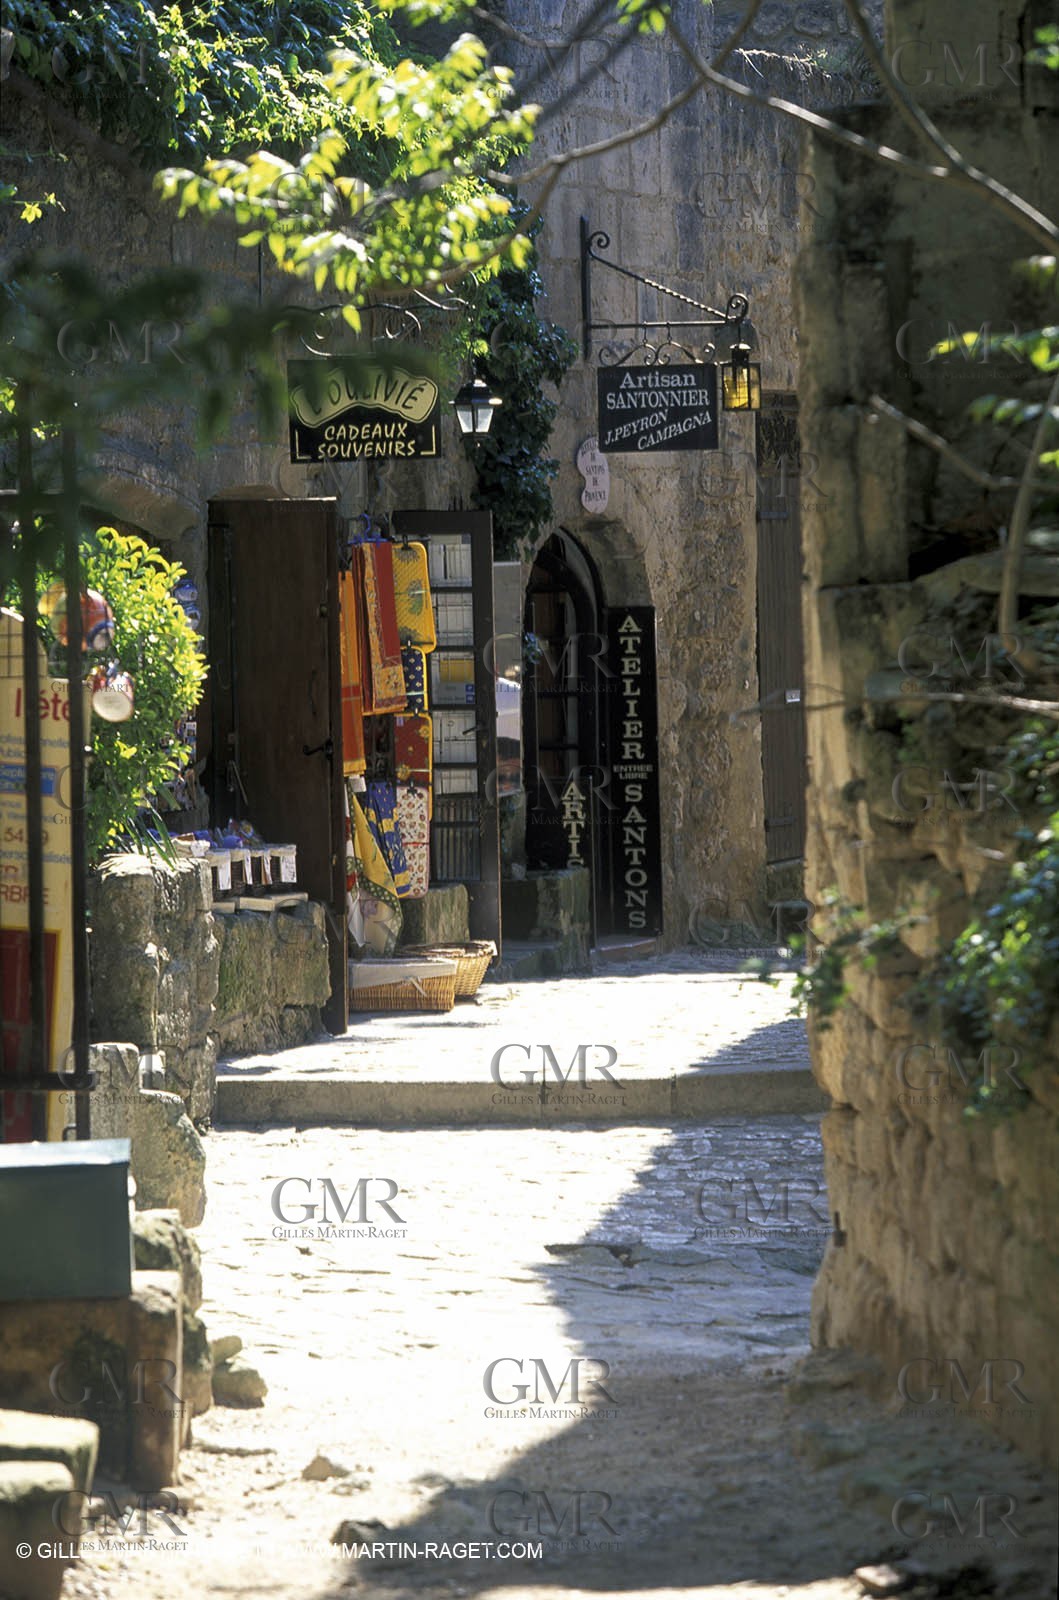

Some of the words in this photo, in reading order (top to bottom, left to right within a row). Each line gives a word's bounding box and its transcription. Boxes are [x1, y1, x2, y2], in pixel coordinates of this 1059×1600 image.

[619, 371, 697, 389] Artisan
[606, 389, 710, 410] SANTONNIER
[324, 422, 408, 441] CADEAUX
[637, 411, 713, 450] CAMPAGNA
[317, 440, 417, 459] SOUVENIRS
[617, 615, 645, 760] ATELIER
[622, 784, 649, 929] SANTONS
